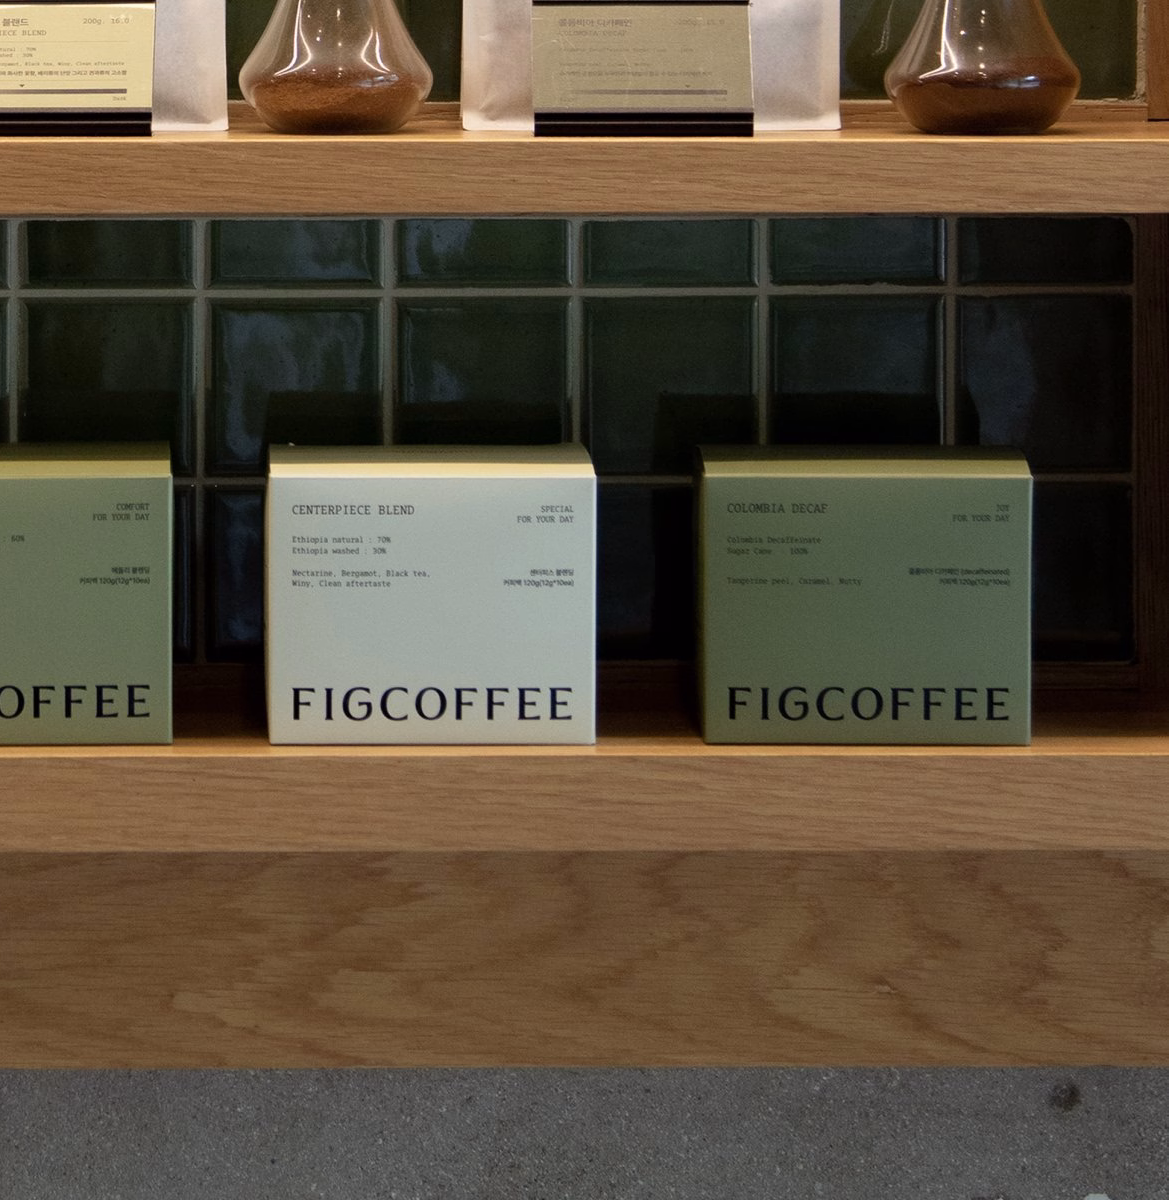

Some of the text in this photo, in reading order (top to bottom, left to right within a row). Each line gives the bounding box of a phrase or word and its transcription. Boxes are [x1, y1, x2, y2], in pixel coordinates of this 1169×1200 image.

[292, 504, 415, 515] CENTERPIECE BLEND
[540, 505, 574, 513] SPECIAL
[727, 503, 828, 514] COLOMBIA DECAF
[135, 513, 150, 521] DAY
[517, 515, 574, 523] FOR YOUR DAY
[292, 536, 328, 544] Ethiopia
[292, 547, 328, 555] Ethiopia
[292, 687, 573, 722] FIGCOFFEE
[727, 686, 1011, 721] FIGCOFFEE
